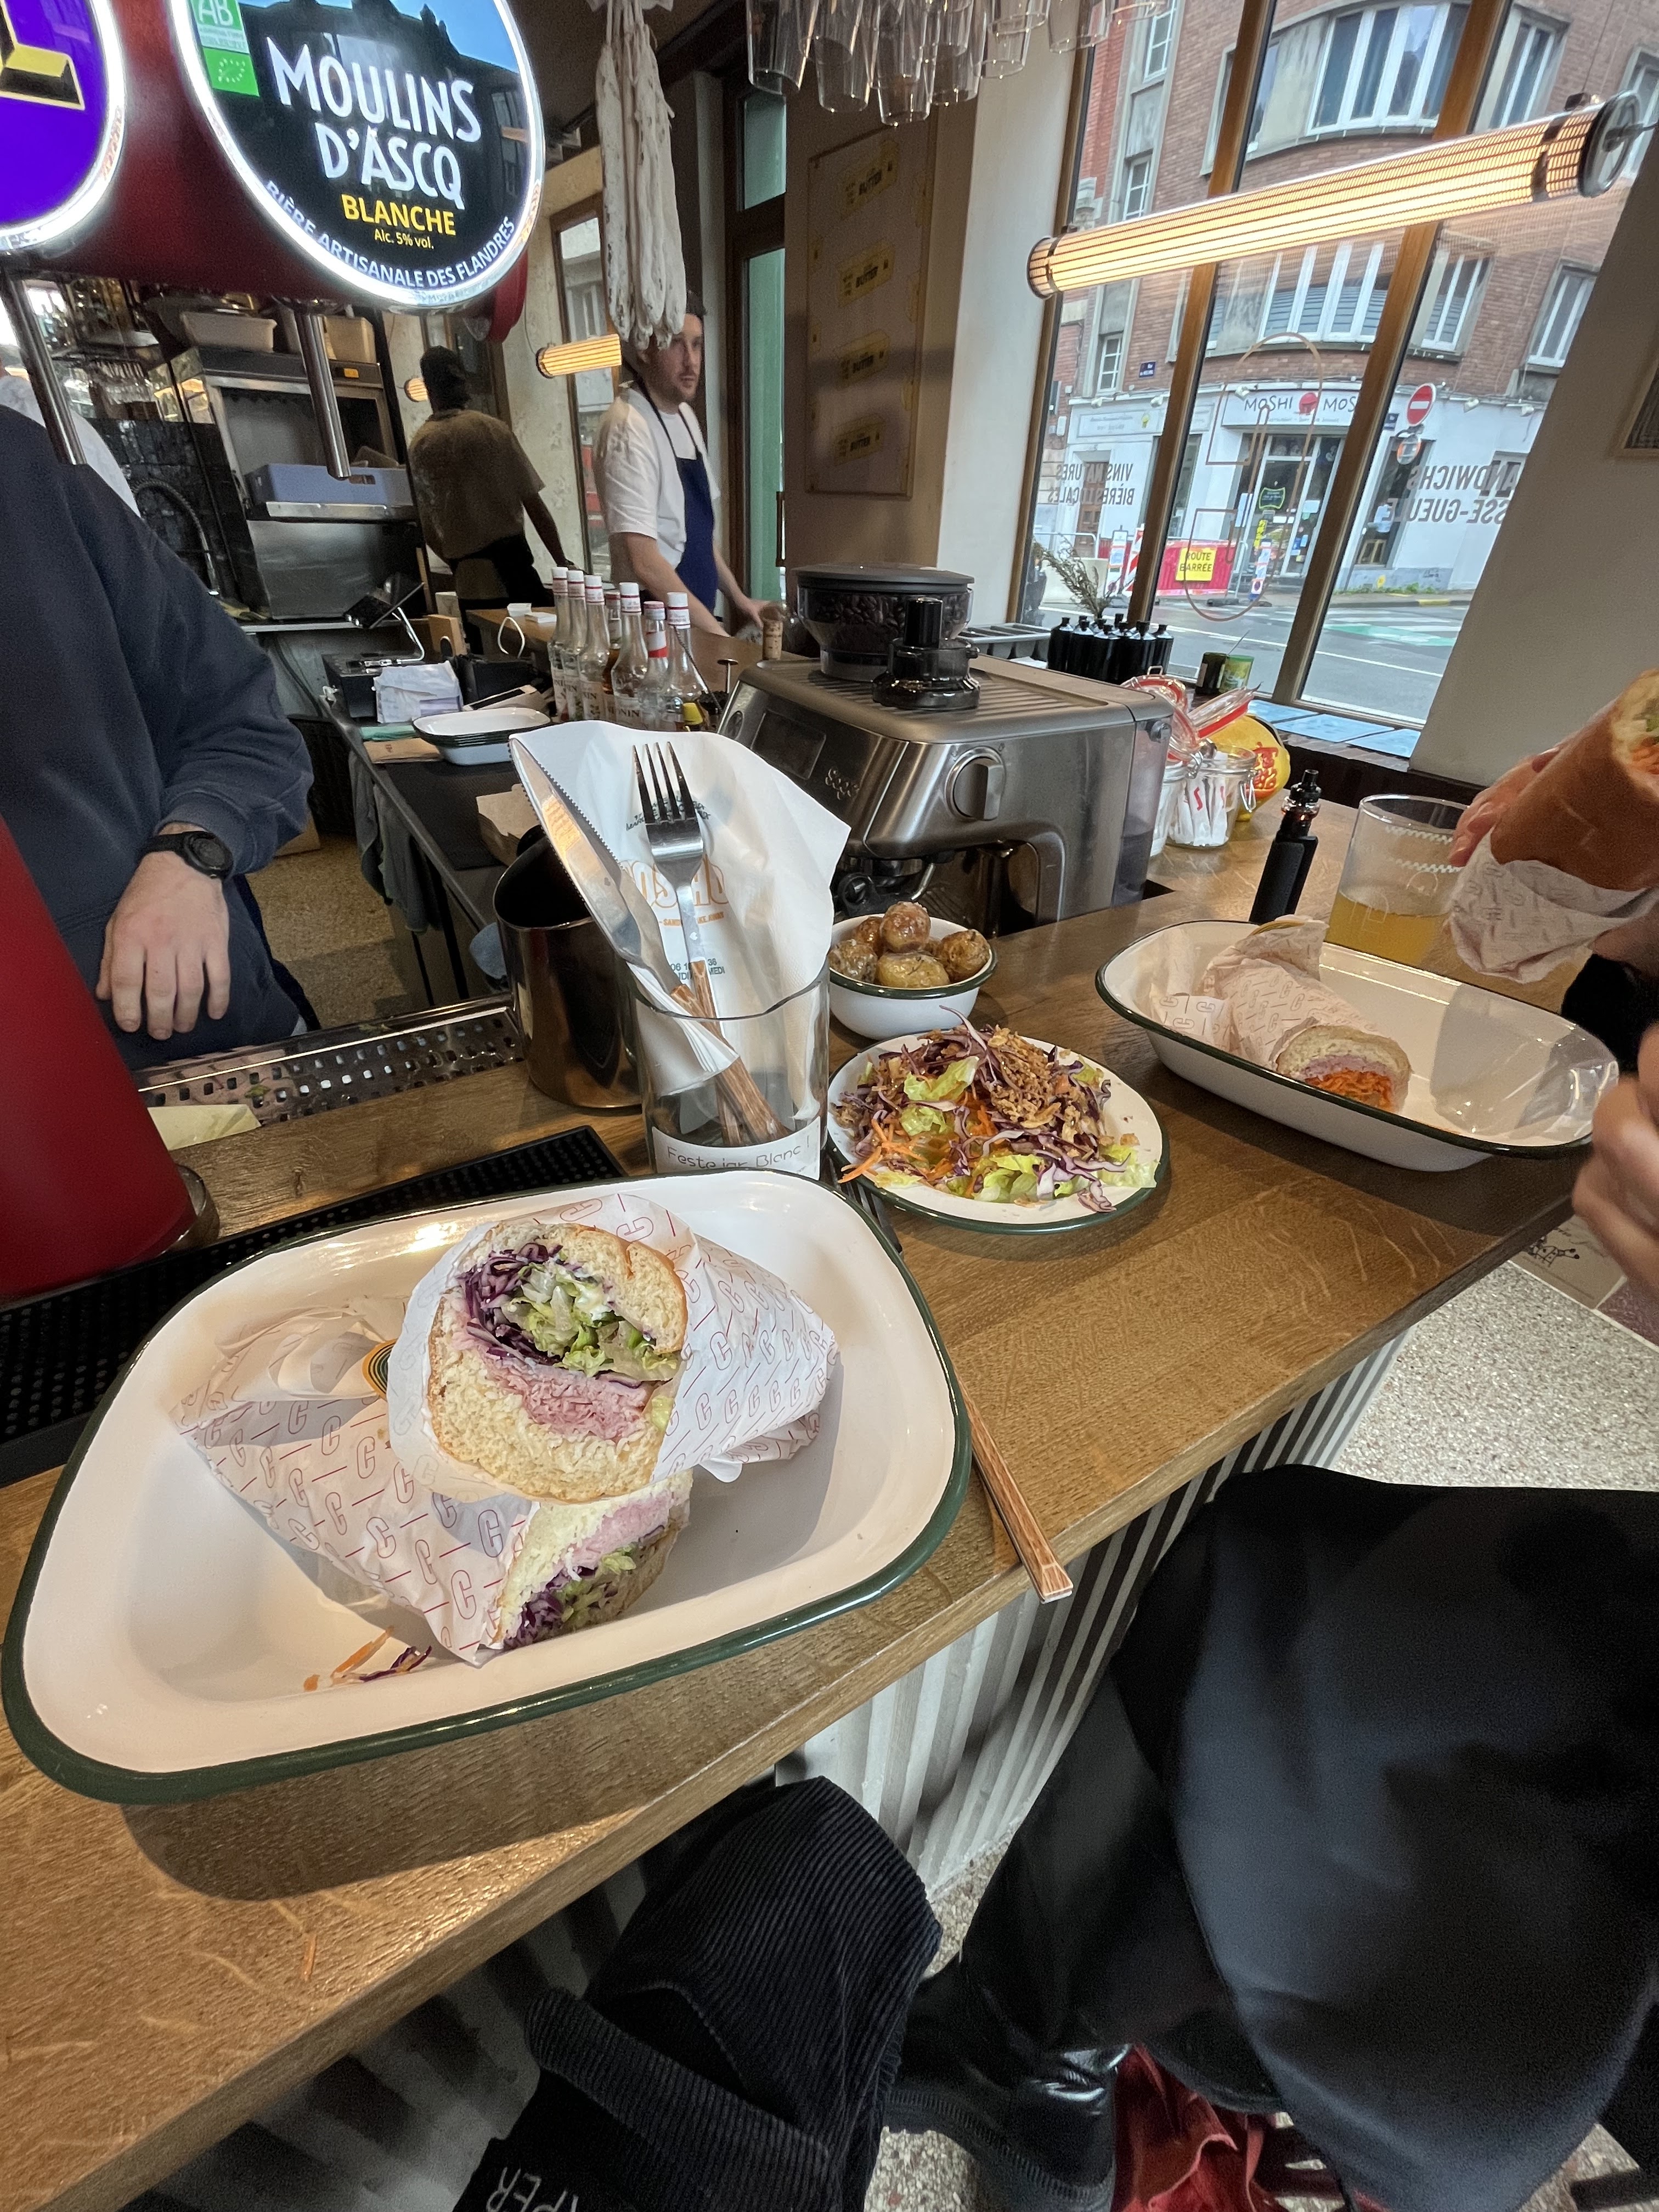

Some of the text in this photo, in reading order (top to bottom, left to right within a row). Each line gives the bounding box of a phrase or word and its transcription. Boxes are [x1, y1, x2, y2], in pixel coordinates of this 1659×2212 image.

[266, 36, 481, 143] MOULINS
[341, 194, 456, 236] BLANCHE
[317, 232, 425, 287] ARTISANALE
[427, 269, 456, 288] DES
[456, 216, 516, 281] FLANDRES
[374, 228, 435, 250] Alc. 5% vol.
[1244, 395, 1356, 412] MOSHI MOS
[756, 1146, 801, 1167] Blanc
